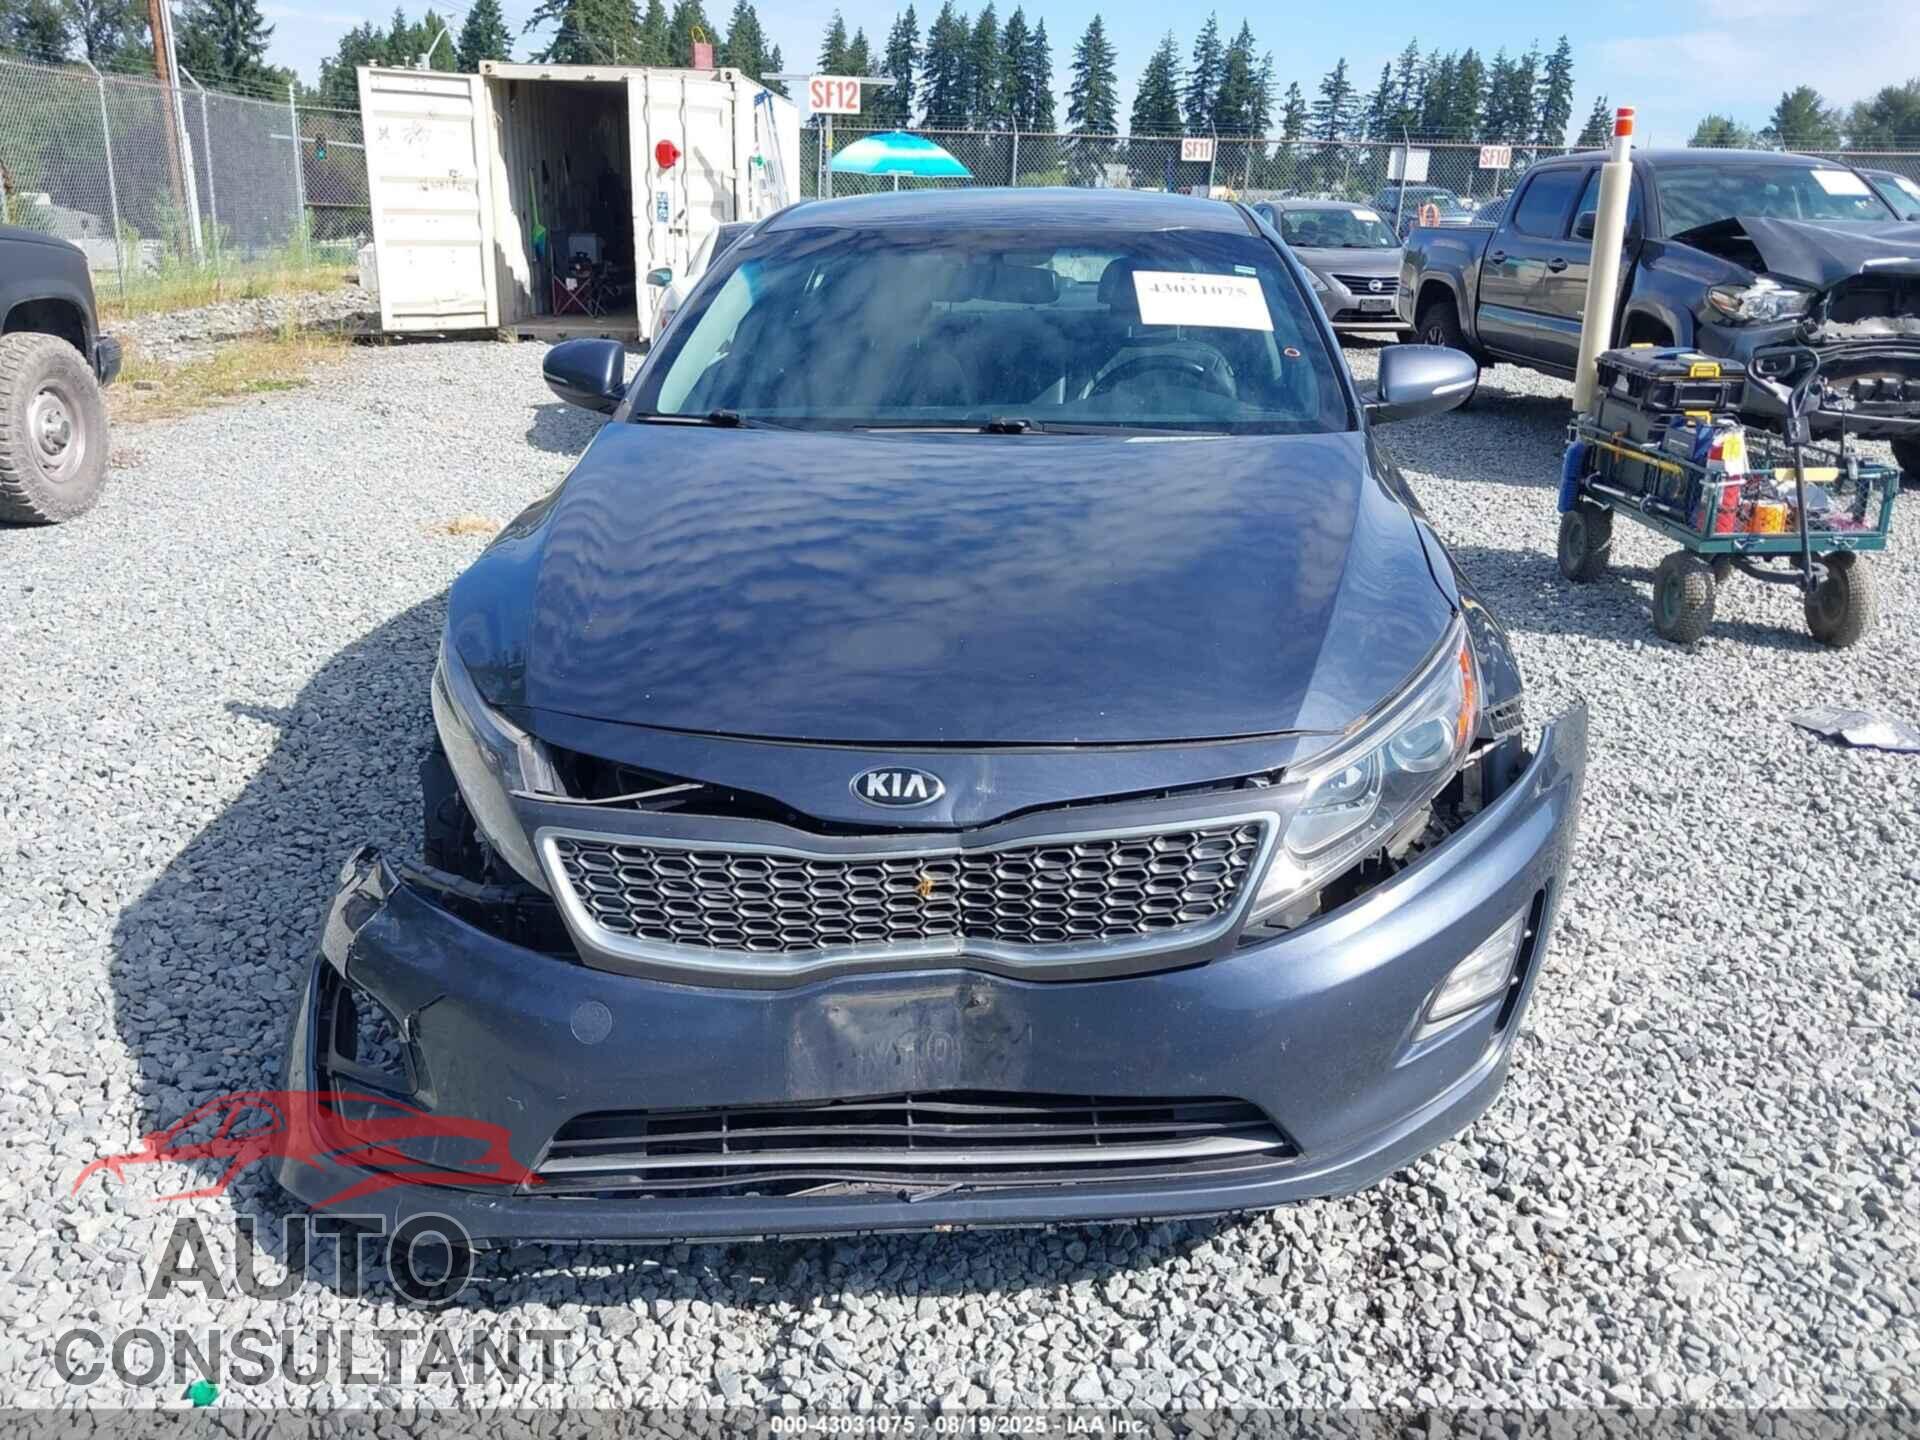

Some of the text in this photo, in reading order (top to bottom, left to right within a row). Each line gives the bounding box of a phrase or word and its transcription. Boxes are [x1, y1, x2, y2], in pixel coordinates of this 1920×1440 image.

[811, 80, 857, 109] SF12
[1184, 141, 1209, 158] SF11
[1481, 149, 1509, 165] SF10
[866, 773, 928, 798] KIA
